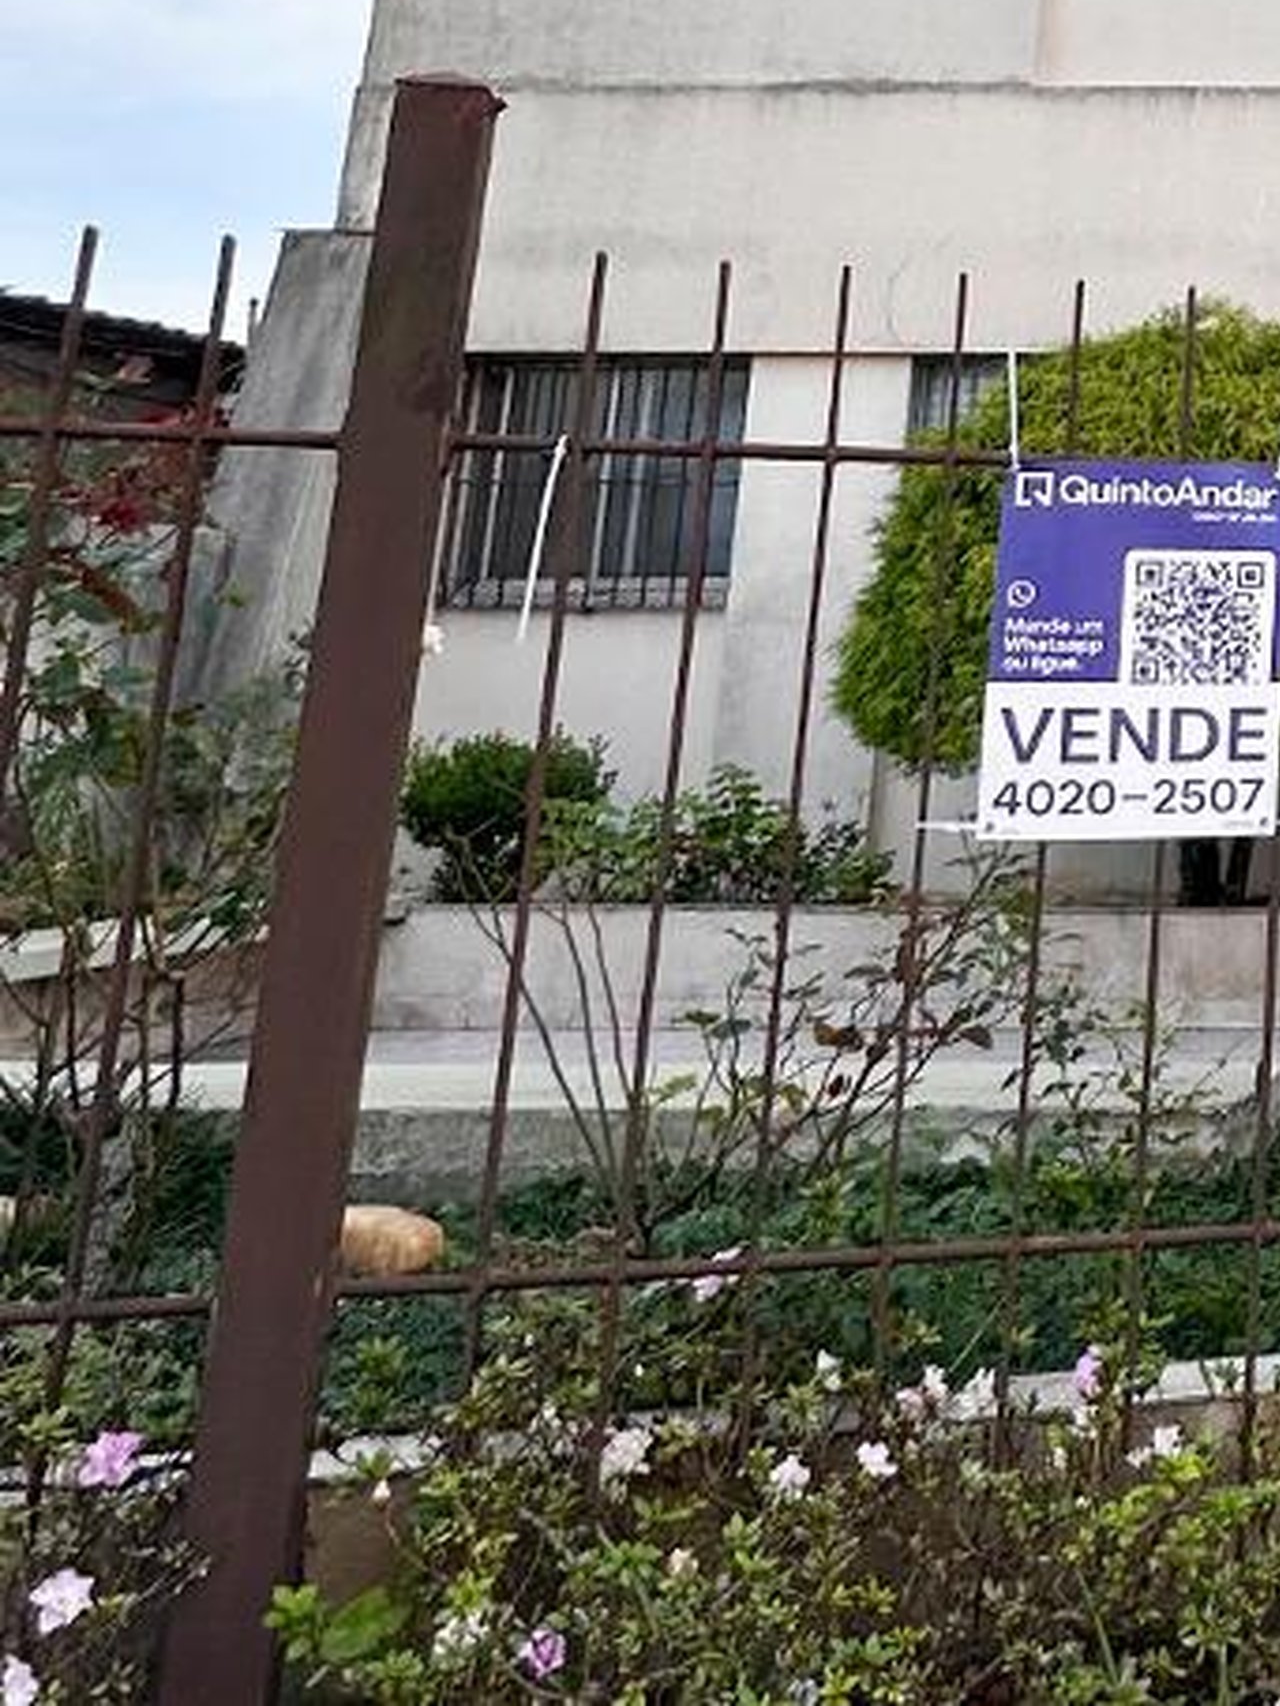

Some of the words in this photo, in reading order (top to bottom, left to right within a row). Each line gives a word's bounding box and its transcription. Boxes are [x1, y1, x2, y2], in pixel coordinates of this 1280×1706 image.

[1060, 475, 1278, 509] QuintoAndar
[1000, 707, 1268, 765] VENDE
[992, 779, 1265, 816] 4020-2507
